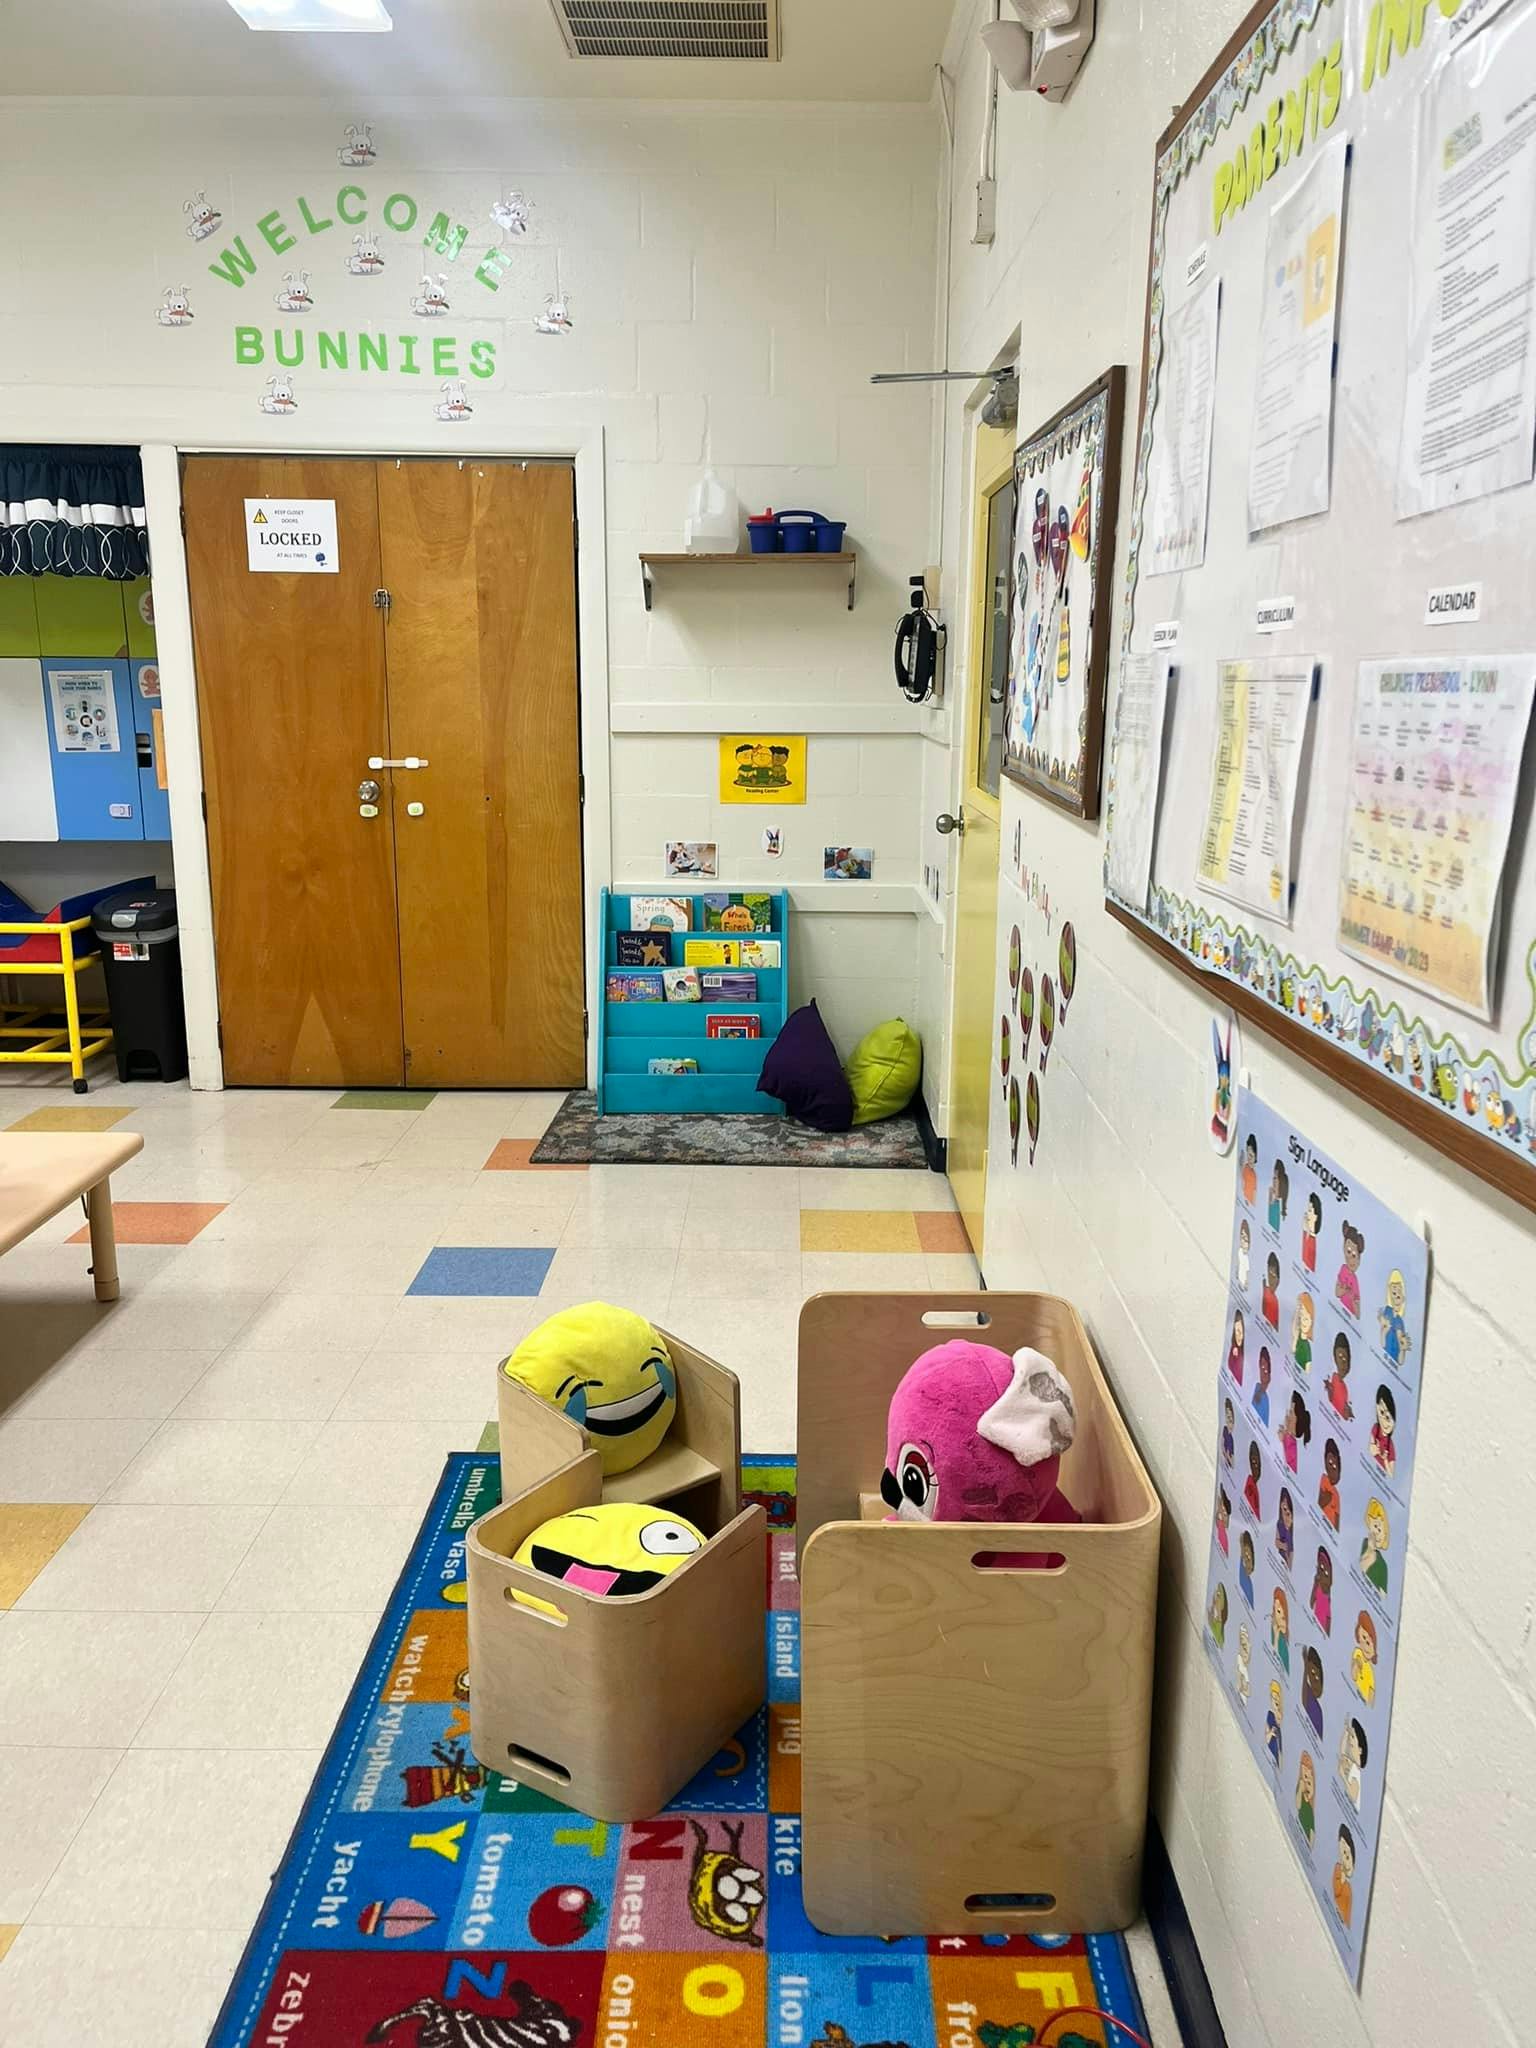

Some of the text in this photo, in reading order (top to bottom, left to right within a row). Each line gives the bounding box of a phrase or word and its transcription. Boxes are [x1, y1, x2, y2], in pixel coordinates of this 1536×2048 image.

[1213, 0, 1462, 236] PARENTS INF
[208, 185, 513, 292] WELCOME
[234, 326, 496, 379] BUNNIES
[260, 532, 322, 546] LOCKED
[1257, 607, 1295, 625] CURRICULUM
[1428, 591, 1476, 614] CALENDAR
[637, 904, 665, 913] Spring
[724, 922, 751, 932] Forest
[1288, 1135, 1349, 1202] Sign Language
[451, 1468, 487, 1529] umbrella
[440, 1539, 467, 1580] vase
[389, 1634, 430, 1702] watch
[775, 1615, 799, 1679] island
[353, 1702, 407, 1812] xylophone
[409, 1820, 467, 1863] Y
[554, 1820, 608, 1857] T
[629, 1820, 686, 1860] N
[774, 1817, 801, 1877] kite
[311, 1840, 362, 1929] yacht
[461, 1832, 514, 1947] tomato
[616, 1873, 646, 1947] nest
[444, 1958, 508, 1999] Z
[683, 1963, 745, 2017] O
[1015, 1971, 1080, 2010] F
[778, 1975, 808, 2044] lion
